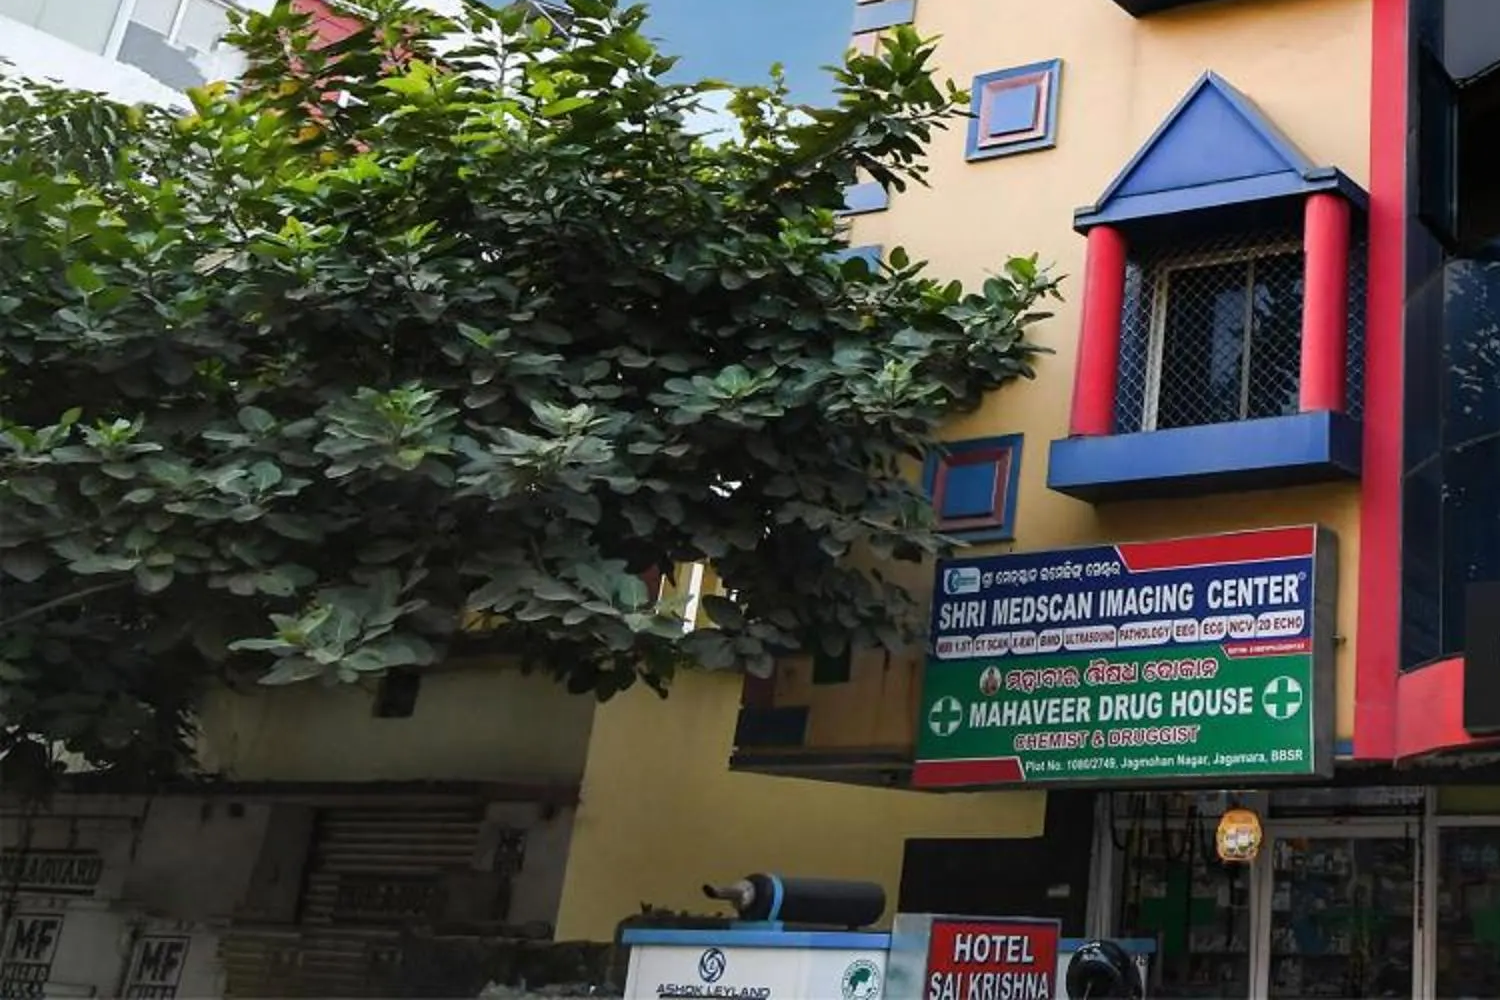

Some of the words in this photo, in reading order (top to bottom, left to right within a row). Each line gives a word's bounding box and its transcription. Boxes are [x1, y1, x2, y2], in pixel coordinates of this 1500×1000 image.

[939, 599, 987, 631] SHRI
[991, 591, 1093, 627] MEDSCAN
[1099, 582, 1194, 618] IMAGING
[1207, 573, 1300, 610] CENTER
[1120, 627, 1171, 642] PATHOLOGY
[1175, 624, 1196, 637] EEG
[1203, 621, 1225, 635] ECG
[1229, 620, 1254, 633] NCV
[1273, 616, 1302, 630] ECHO
[968, 696, 1091, 729] MAHAVEER
[1098, 691, 1163, 722] DRUG
[1171, 686, 1254, 717] HOUSE
[1013, 730, 1089, 751] CHEMIST
[1091, 730, 1105, 748] &
[1107, 724, 1200, 746] DRUGGIST
[1025, 759, 1045, 772] Plot
[1120, 754, 1175, 772] Jagmohan
[1271, 749, 1303, 762] BBSR
[954, 933, 1034, 963] HOTEL
[656, 983, 703, 995] ASHOK
[706, 985, 771, 999] LEYLAND
[929, 971, 963, 1000] SAI
[967, 971, 1050, 1000] KRISHNA
